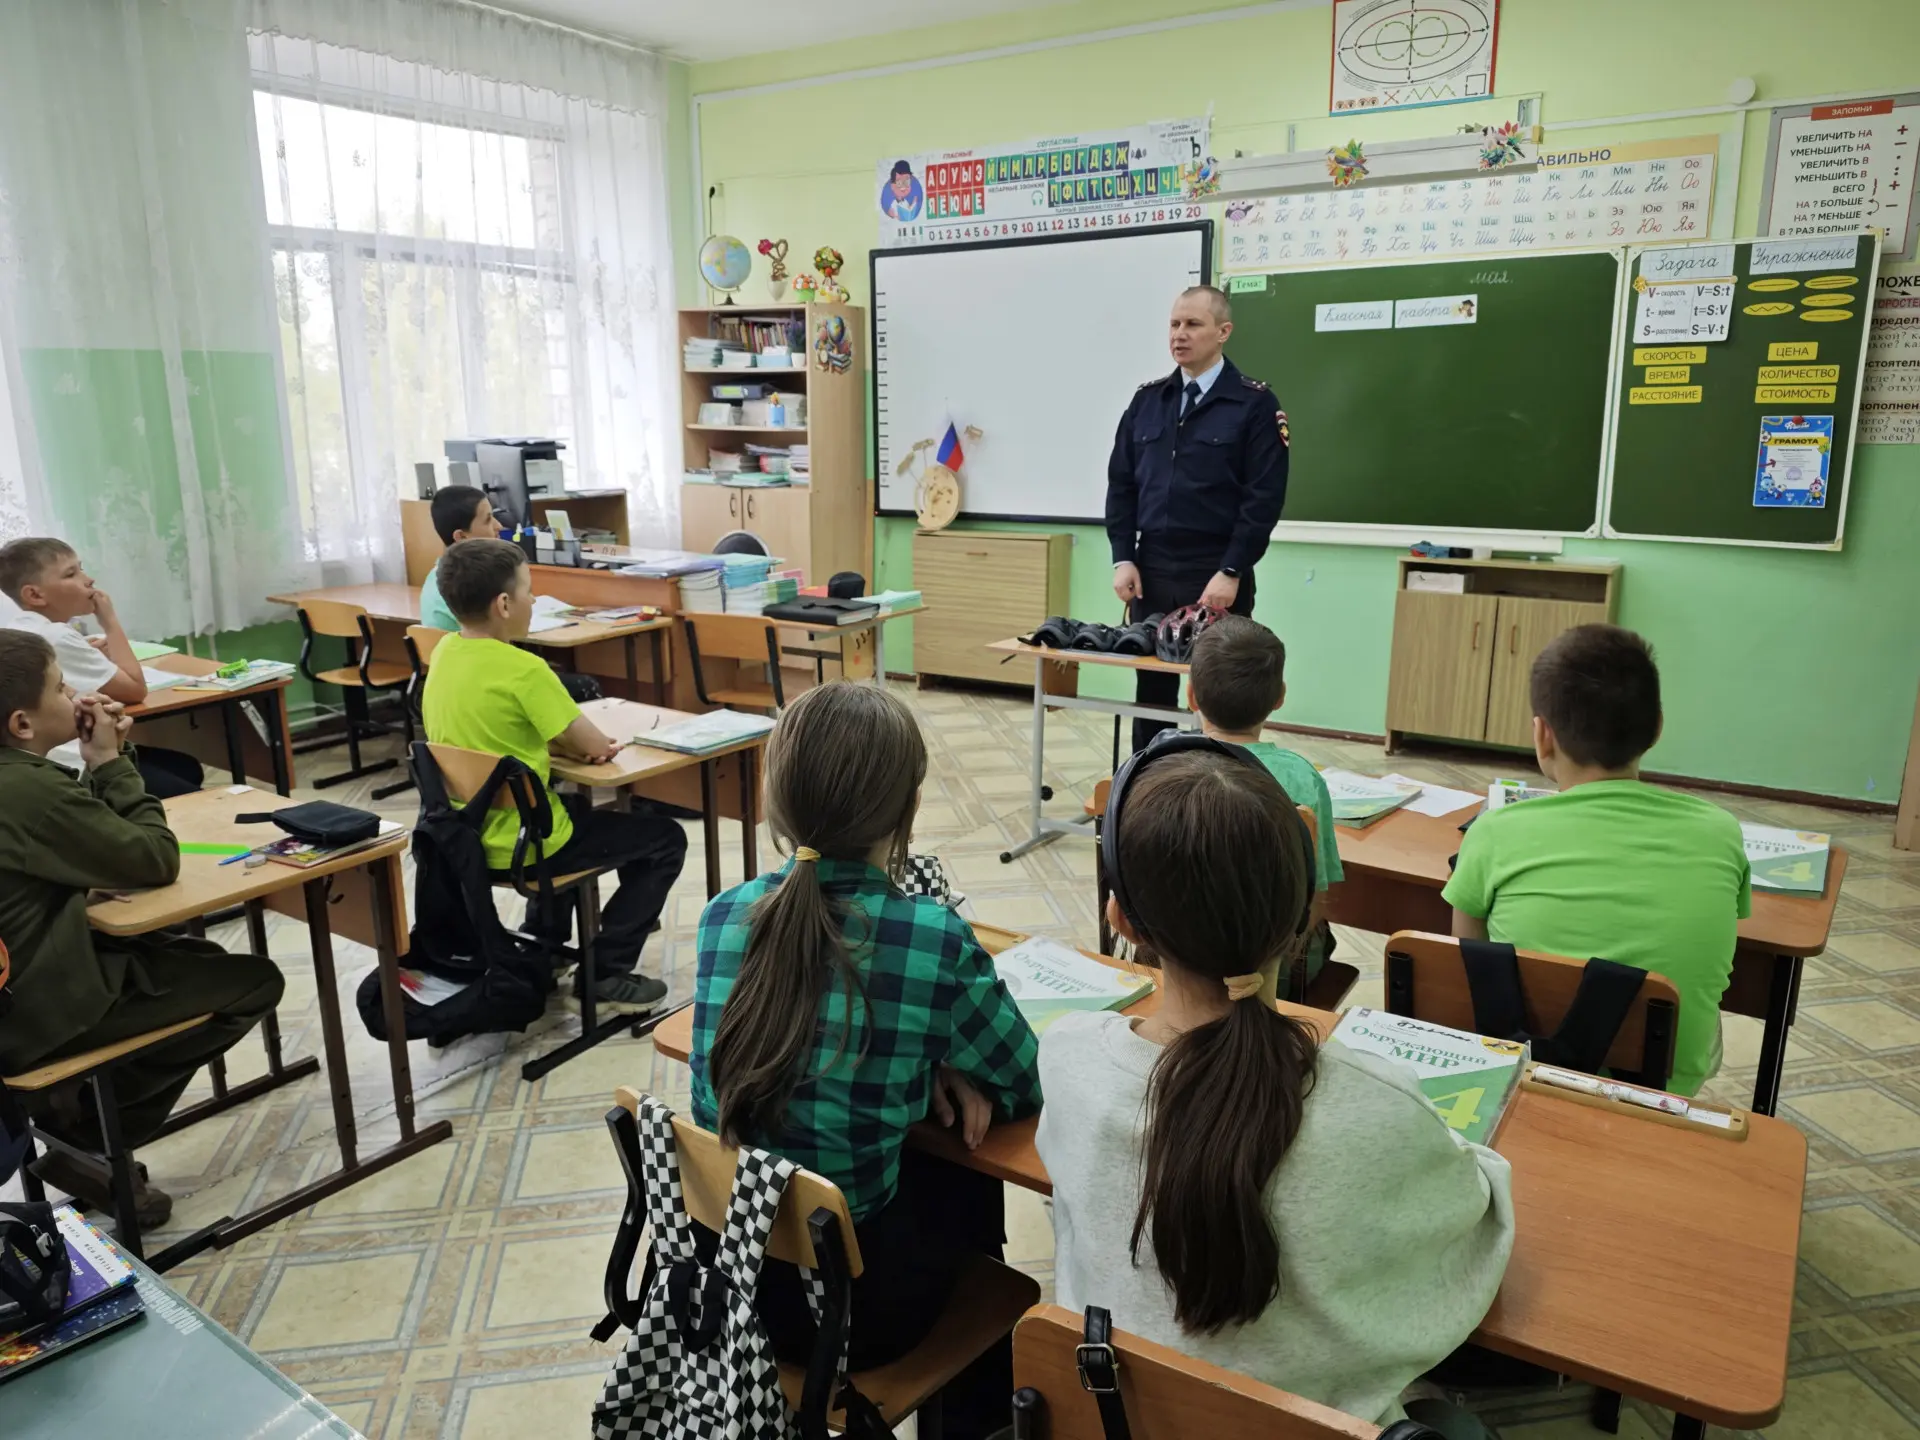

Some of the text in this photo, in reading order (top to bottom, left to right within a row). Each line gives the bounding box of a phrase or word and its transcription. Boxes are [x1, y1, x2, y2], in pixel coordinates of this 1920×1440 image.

[1832, 106, 1872, 115] ЗАПОМНИ
[1796, 129, 1872, 143] УВЕЛИЧИТЬ НА
[1790, 143, 1871, 156] УМЕНЬШИТЬ НА
[1613, 166, 1632, 175] Мм
[1651, 163, 1665, 172] Нн
[1685, 160, 1699, 168] Оо
[1800, 158, 1860, 169] УВЕЛИЧИТЬ
[1795, 170, 1867, 183] УМЕНЬШИТЬ В
[1833, 184, 1865, 194] ВСЕГО
[1643, 204, 1662, 213] Юю
[1682, 202, 1694, 210] Яя
[1820, 197, 1863, 207] БОЛЬШЕ
[1794, 214, 1807, 222] НА
[1818, 210, 1862, 221] МЕНЬШЕ
[929, 206, 1201, 240] 0 1 2 3 4 5 6 7 8 9 10 11 12 13 14 15 16 17 18 19 20
[1779, 228, 1786, 236] В
[1656, 252, 1719, 276] Задача
[1753, 247, 1855, 272] Упражнение
[1236, 280, 1262, 289] Тема:
[1324, 301, 1450, 323] Классная работа
[1642, 351, 1696, 361] СКОРОСТЬ
[1776, 347, 1809, 358] ЦЕНА
[1648, 370, 1687, 380] ВРЕМЯ
[1760, 368, 1836, 379] КОЛИЧЕСТВО
[1632, 390, 1699, 400] РАССТОЯНИЕ
[1760, 389, 1830, 399] СТОИМОСТЬ
[1768, 862, 1815, 881] 4
[1014, 952, 1108, 992] Окружающий
[1027, 971, 1081, 994] МИР
[1352, 1026, 1486, 1065] Окружающий
[1388, 1046, 1460, 1068] МИР
[1430, 1087, 1485, 1130] 4
